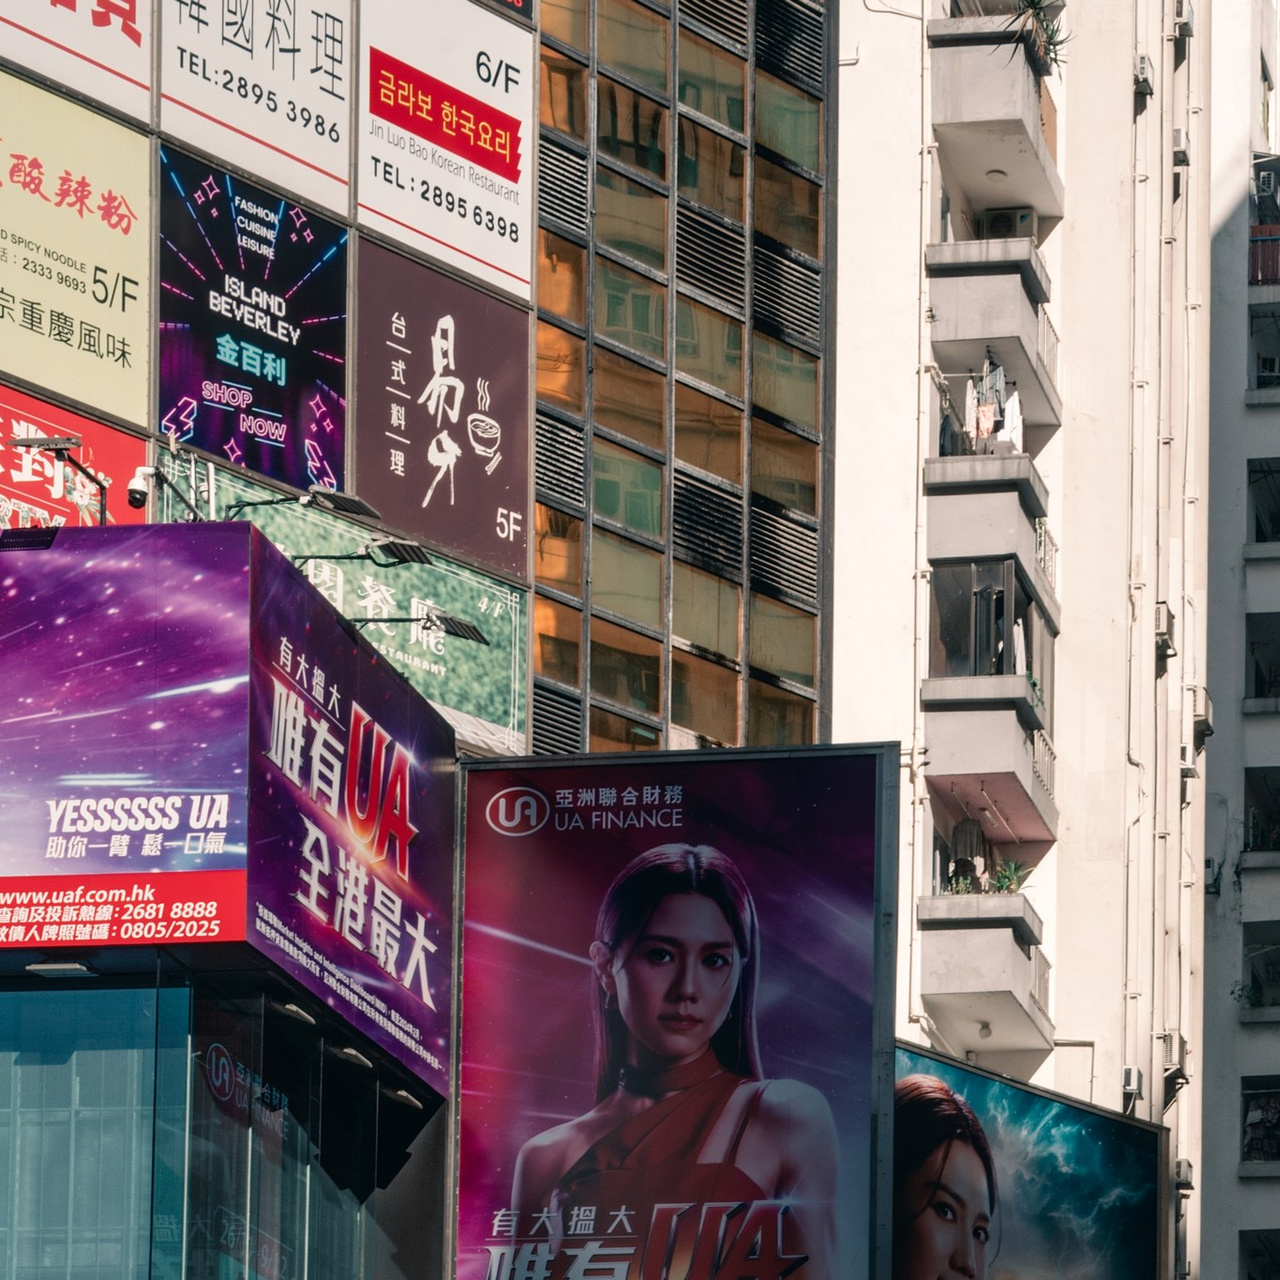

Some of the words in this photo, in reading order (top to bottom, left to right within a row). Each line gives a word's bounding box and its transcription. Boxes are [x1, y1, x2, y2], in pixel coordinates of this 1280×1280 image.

[476, 51, 520, 93] 6/F
[286, 101, 340, 143] 3986
[379, 70, 433, 121] 금라보
[441, 101, 510, 163] 한국요리
[369, 119, 384, 137] Jin
[387, 130, 406, 150] Luo
[409, 138, 428, 160] Bao
[431, 147, 466, 177] Korean
[468, 165, 519, 205] Restaurant
[0, 153, 138, 236] 酸辣粉
[235, 196, 278, 225] FASHION
[421, 180, 468, 219] 2895
[473, 205, 519, 243] 6398
[237, 216, 276, 241] CUISINE
[11, 234, 41, 254] SPICY
[44, 248, 87, 274] NOODLE
[237, 234, 275, 260] LEISURE
[22, 257, 52, 280] 2333
[57, 272, 87, 294] 9693
[92, 265, 139, 313] 5/F
[225, 274, 286, 318] ISLAND
[209, 291, 300, 346] BEVERLEY
[216, 333, 286, 386] 金百利
[202, 381, 252, 408] SHOP
[240, 414, 287, 441] NOW
[496, 507, 522, 541] 5F
[189, 795, 229, 829] UA
[555, 785, 684, 807] 亞洲聯合財務
[555, 810, 585, 831] UA
[591, 808, 683, 831] FINANCE
[45, 836, 131, 859] 助你一臂
[141, 832, 226, 857] 鬆一口氣
[0, 885, 155, 905] www.uaf.com.hk
[170, 902, 217, 919] 8888
[290, 812, 438, 1014] 全港最大
[492, 1206, 636, 1237] 有大搵大
